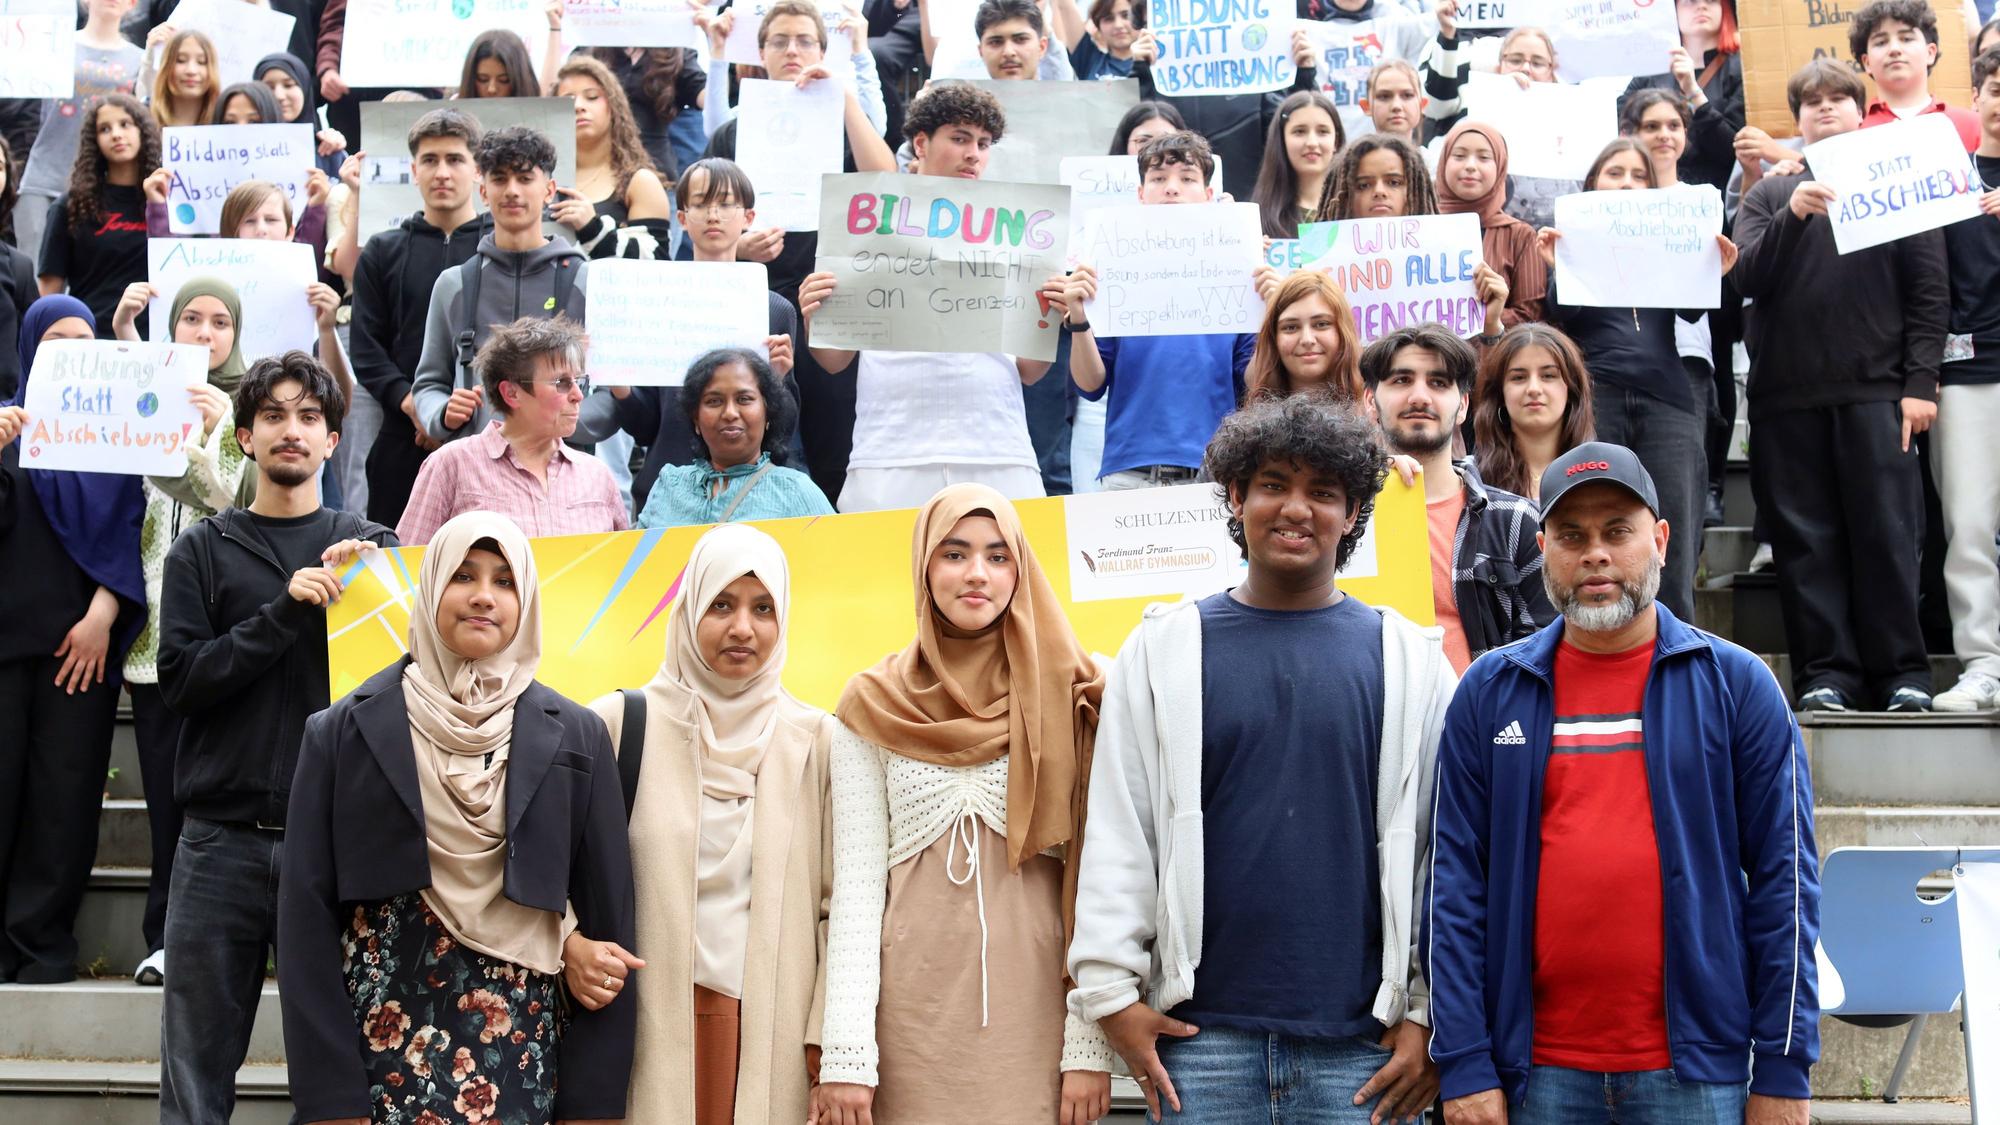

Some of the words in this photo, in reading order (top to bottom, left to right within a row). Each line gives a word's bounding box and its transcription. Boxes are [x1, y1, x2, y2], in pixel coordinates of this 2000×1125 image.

[1152, 0, 1270, 28] BILDUNG
[1804, 0, 1855, 27] Bildun
[1155, 25, 1232, 60] STATT
[1156, 55, 1290, 92] ABSCHIEBUNG
[169, 135, 249, 165] Bildung
[1867, 155, 1913, 182] STATT
[847, 193, 1056, 250] BILDUNG
[1090, 220, 1197, 257] Abschiebung
[1202, 231, 1215, 247] ist
[1353, 219, 1420, 255] WIR
[851, 247, 940, 277] endet
[958, 250, 1043, 283] NICHT
[1326, 258, 1393, 294] IND
[1405, 250, 1474, 287] ALLE
[866, 288, 906, 309] an
[929, 288, 1026, 313] Grenzen
[52, 351, 155, 389] Bildung
[61, 384, 113, 415] Statt
[28, 418, 193, 456] Abschiebung!
[1564, 461, 1610, 477] HUGO
[1115, 503, 1229, 529] SCHULZENTRU
[1097, 547, 1144, 559] Ferdinand
[1145, 544, 1174, 555] Franz
[1098, 557, 1145, 573] WALLRAF
[1147, 552, 1211, 569] GYMNASIUM
[1493, 735, 1526, 745] adidas
